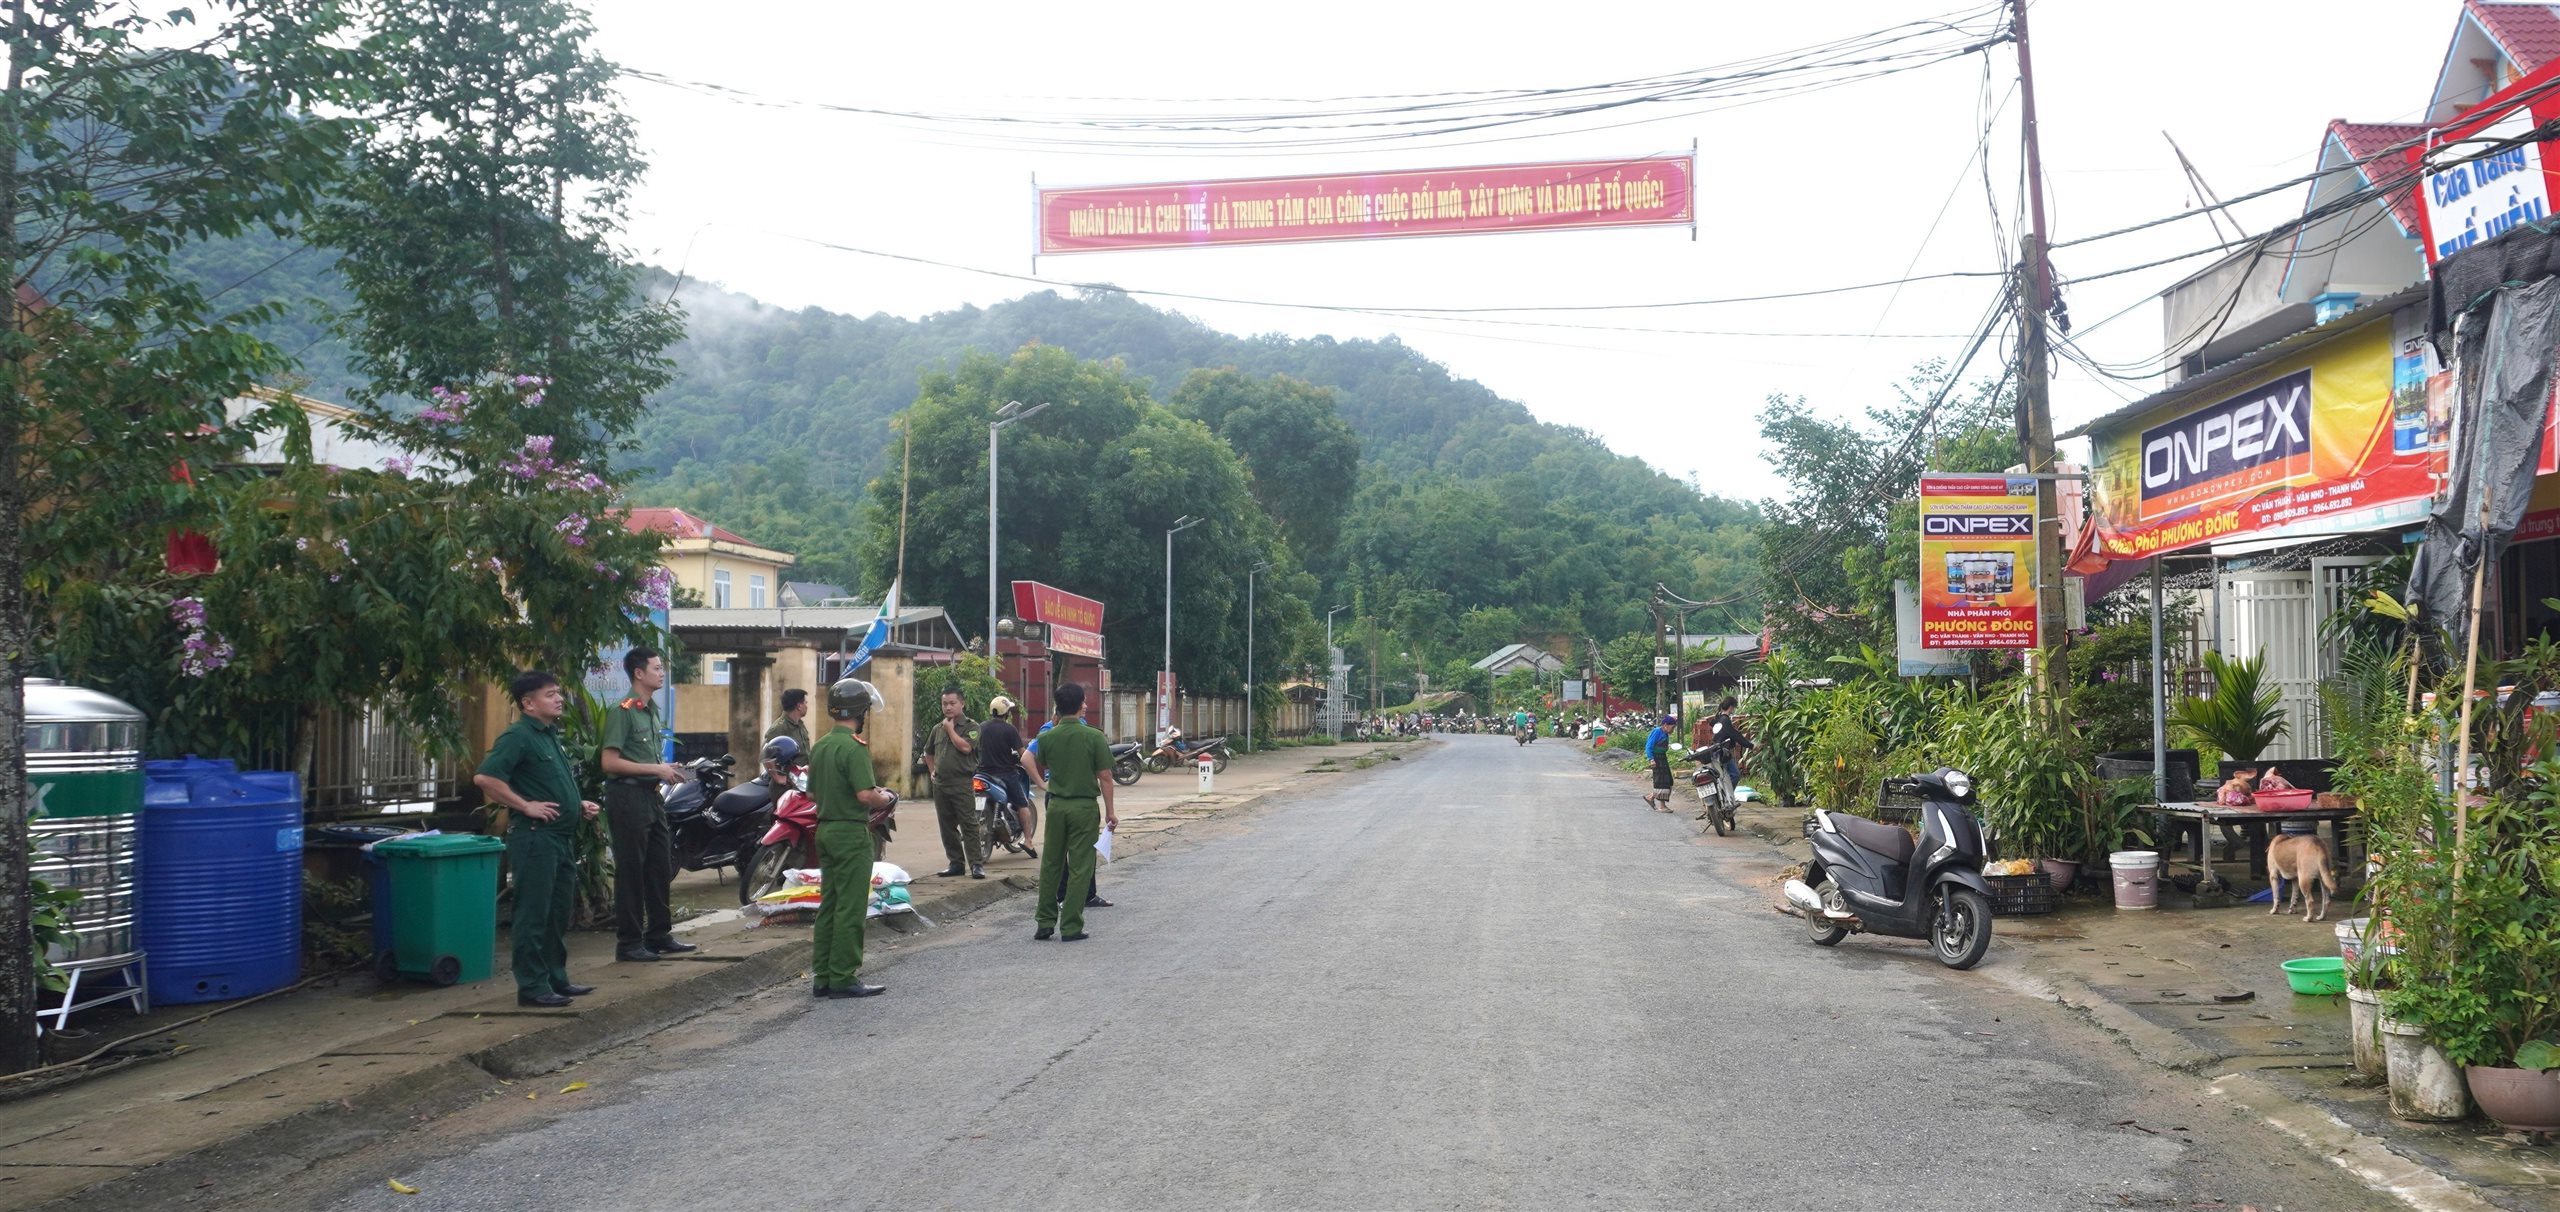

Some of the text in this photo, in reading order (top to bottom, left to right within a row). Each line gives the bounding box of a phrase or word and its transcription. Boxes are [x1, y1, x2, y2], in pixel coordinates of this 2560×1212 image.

[1069, 170, 1664, 237] NHÂN DÂN LÀ CHỦ THỂ, LÀ TRUNG TÂM CỦA CÔNG CUỘC ĐỔI MỚI, XÂY DỰNG VÀ BẢO VỆ TỔ QUỐC!
[2145, 385, 2305, 489] ONPEX
[2311, 489, 2324, 500] NHO
[2328, 484, 2350, 496] THANH
[1926, 518, 2030, 533] ONPEX
[2161, 520, 2203, 547] PHƯƠNG
[2205, 511, 2239, 536] ĐÔNG
[2528, 518, 2554, 533] trung
[1947, 608, 2012, 617] NHÀ PHÂN PHỐI
[1924, 618, 2034, 632] PHƯƠNG ĐÔNG
